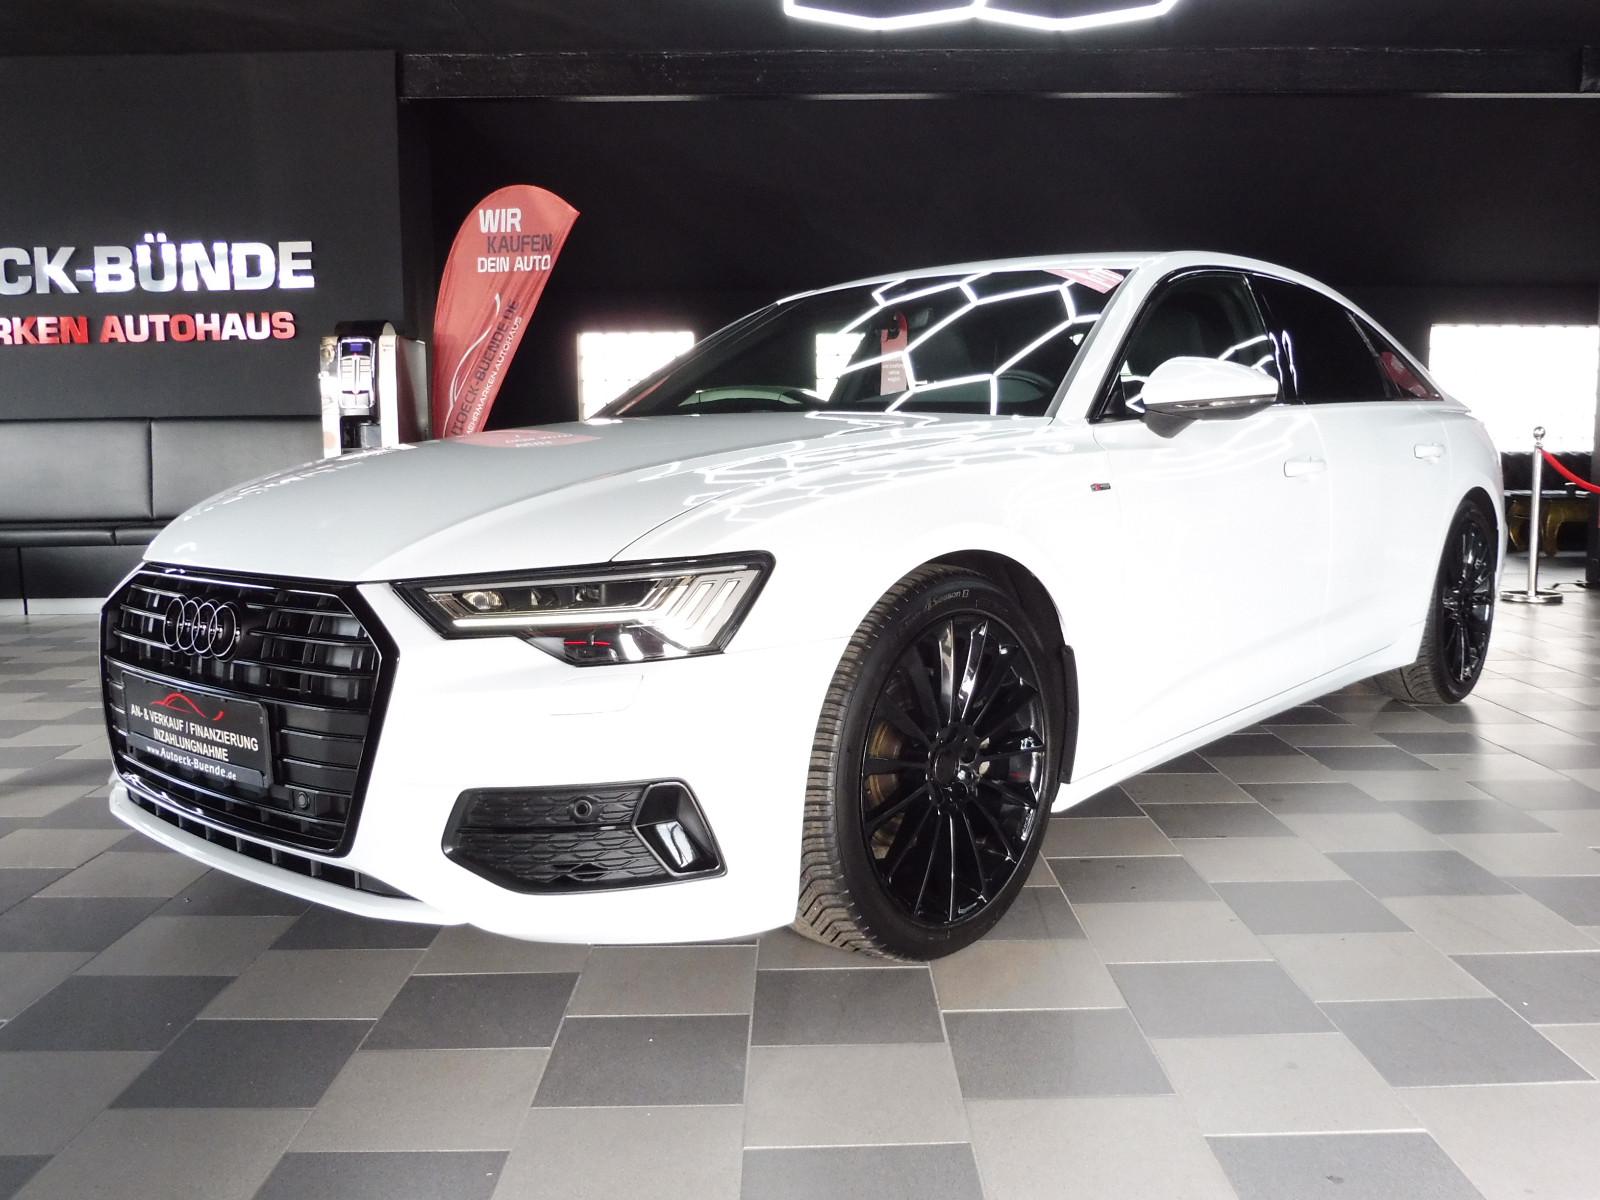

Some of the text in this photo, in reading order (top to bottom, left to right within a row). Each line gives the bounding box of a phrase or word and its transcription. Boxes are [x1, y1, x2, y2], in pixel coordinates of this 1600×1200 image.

[479, 208, 521, 233] WIR
[487, 234, 552, 254] KAUFEN
[0, 232, 315, 295] CK-BÜNDE
[477, 254, 551, 273] DEIN AUTO
[100, 312, 296, 343] AUTOHAUS
[496, 316, 523, 371] AUTOHAUS
[149, 709, 184, 731] VERKAUF
[190, 721, 259, 751] FINANZIERUNG
[153, 727, 229, 762] INZAHLUNGNAHME
[146, 746, 237, 780] www.Autoeck-Buende.de
